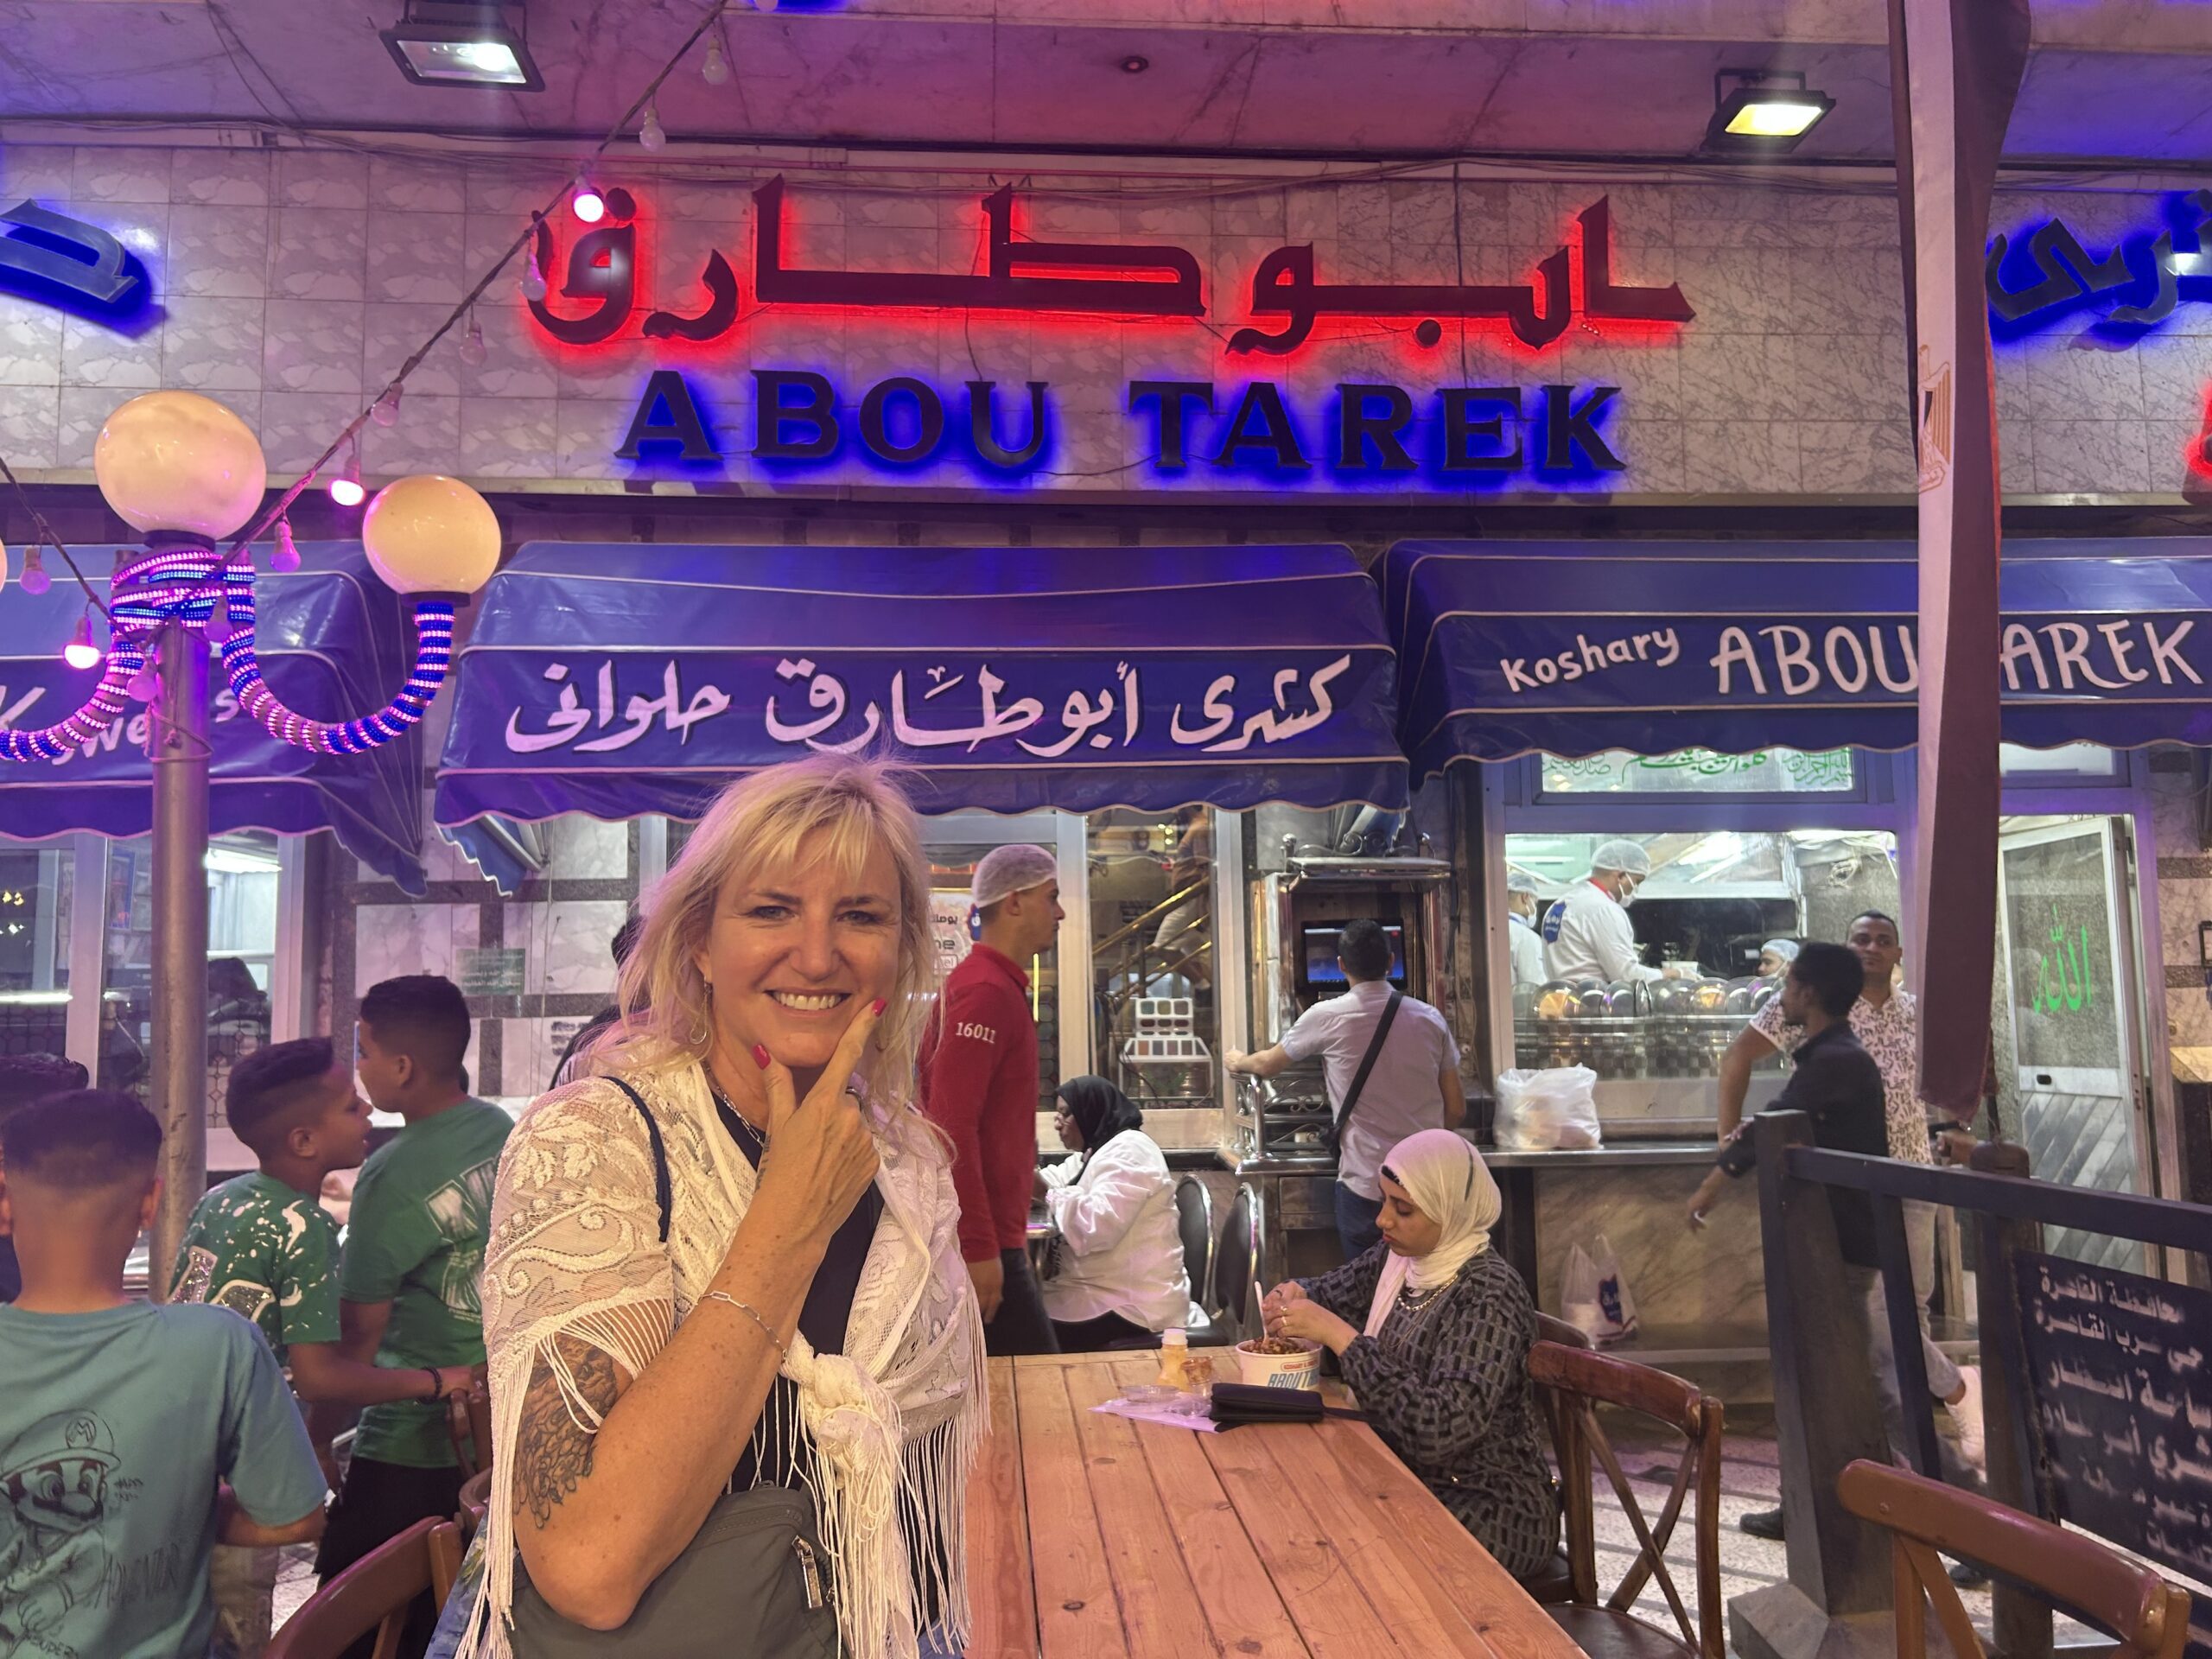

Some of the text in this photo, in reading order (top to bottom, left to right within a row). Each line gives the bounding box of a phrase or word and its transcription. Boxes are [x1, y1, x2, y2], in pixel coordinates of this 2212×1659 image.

[523, 173, 1696, 356] ابو طارق
[613, 369, 1628, 471] ABOU TAREK
[505, 659, 731, 753] حلوانى
[1500, 619, 2204, 696] Koshary ABOU AREK
[766, 658, 1045, 755] طارق
[1017, 661, 1138, 758] أبو
[2030, 902, 2091, 1017] الله
[955, 1021, 996, 1044] 16011
